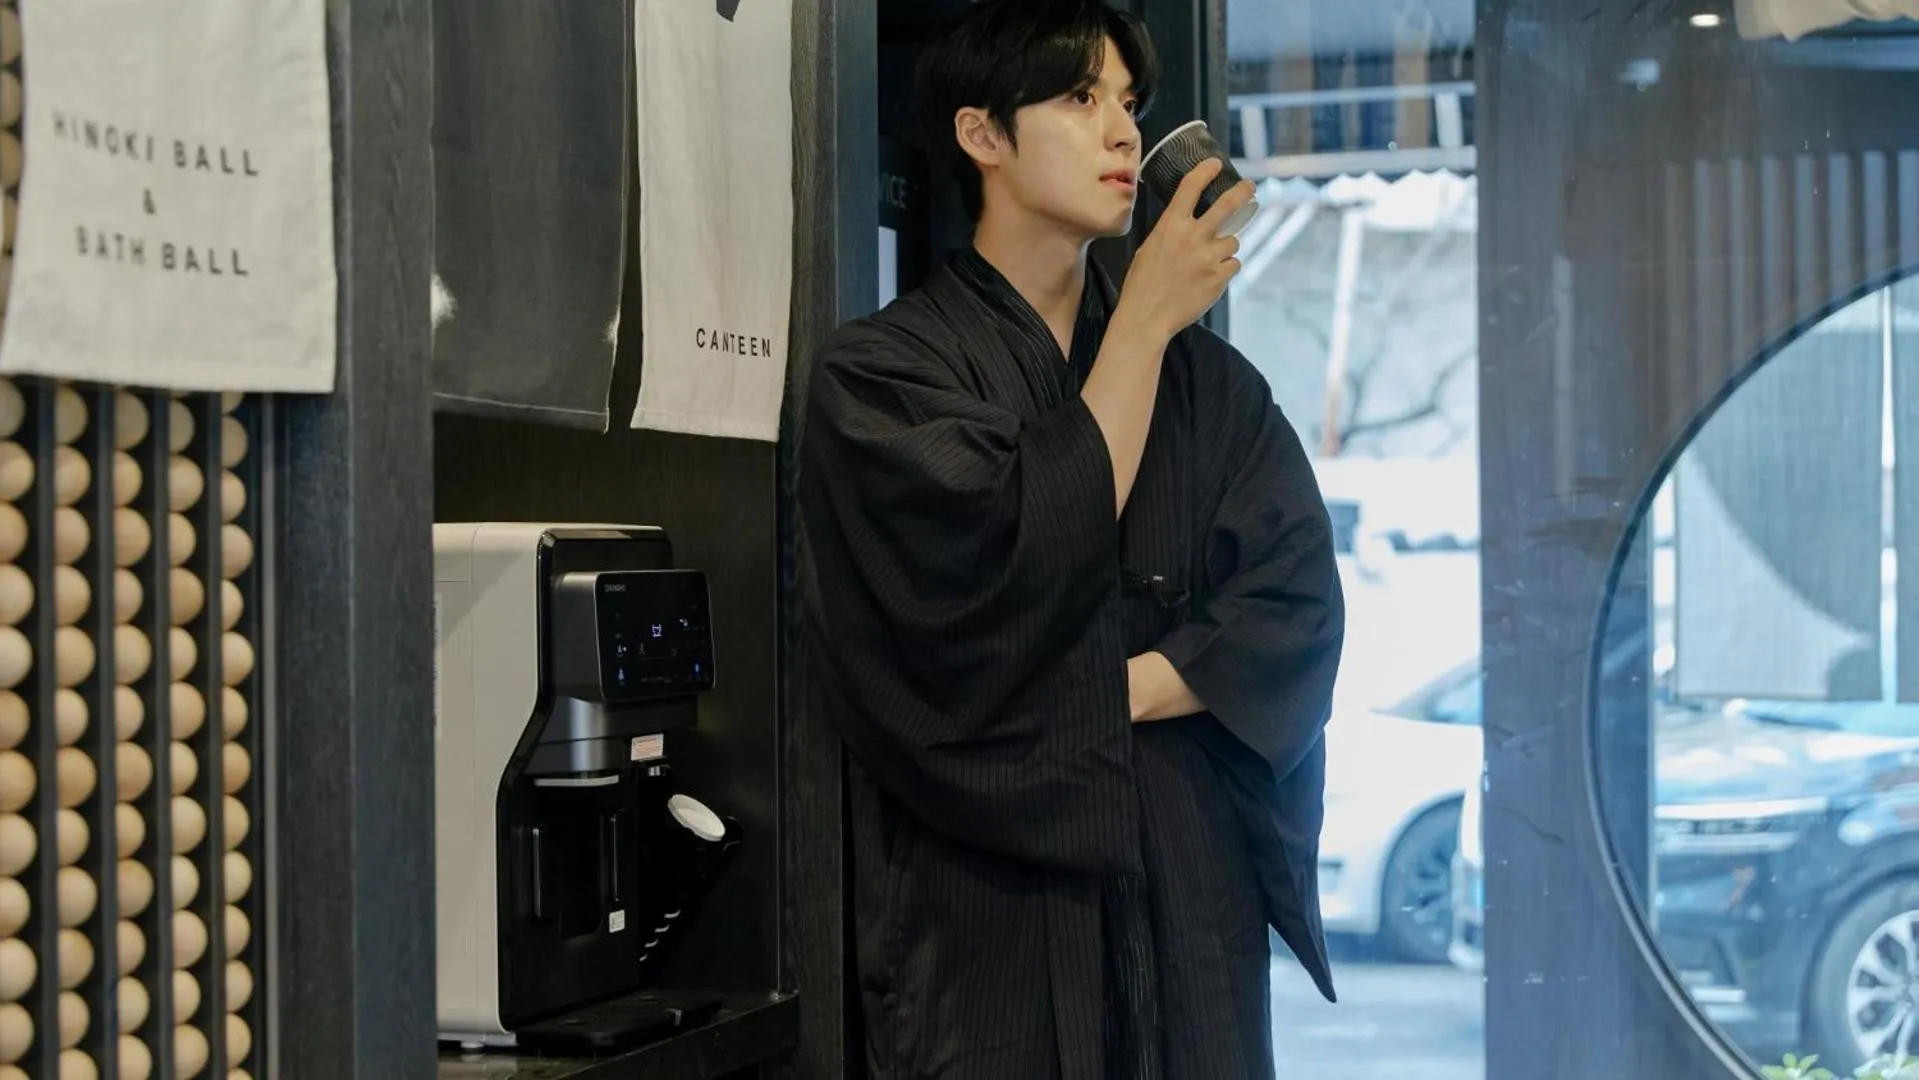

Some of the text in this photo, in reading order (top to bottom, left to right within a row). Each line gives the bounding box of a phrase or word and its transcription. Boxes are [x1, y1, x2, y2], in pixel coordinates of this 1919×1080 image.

[53, 111, 259, 176] HINOKI BALL
[142, 188, 156, 215] &
[76, 226, 250, 276] BATH BALL
[696, 327, 771, 358] CANTEEN
